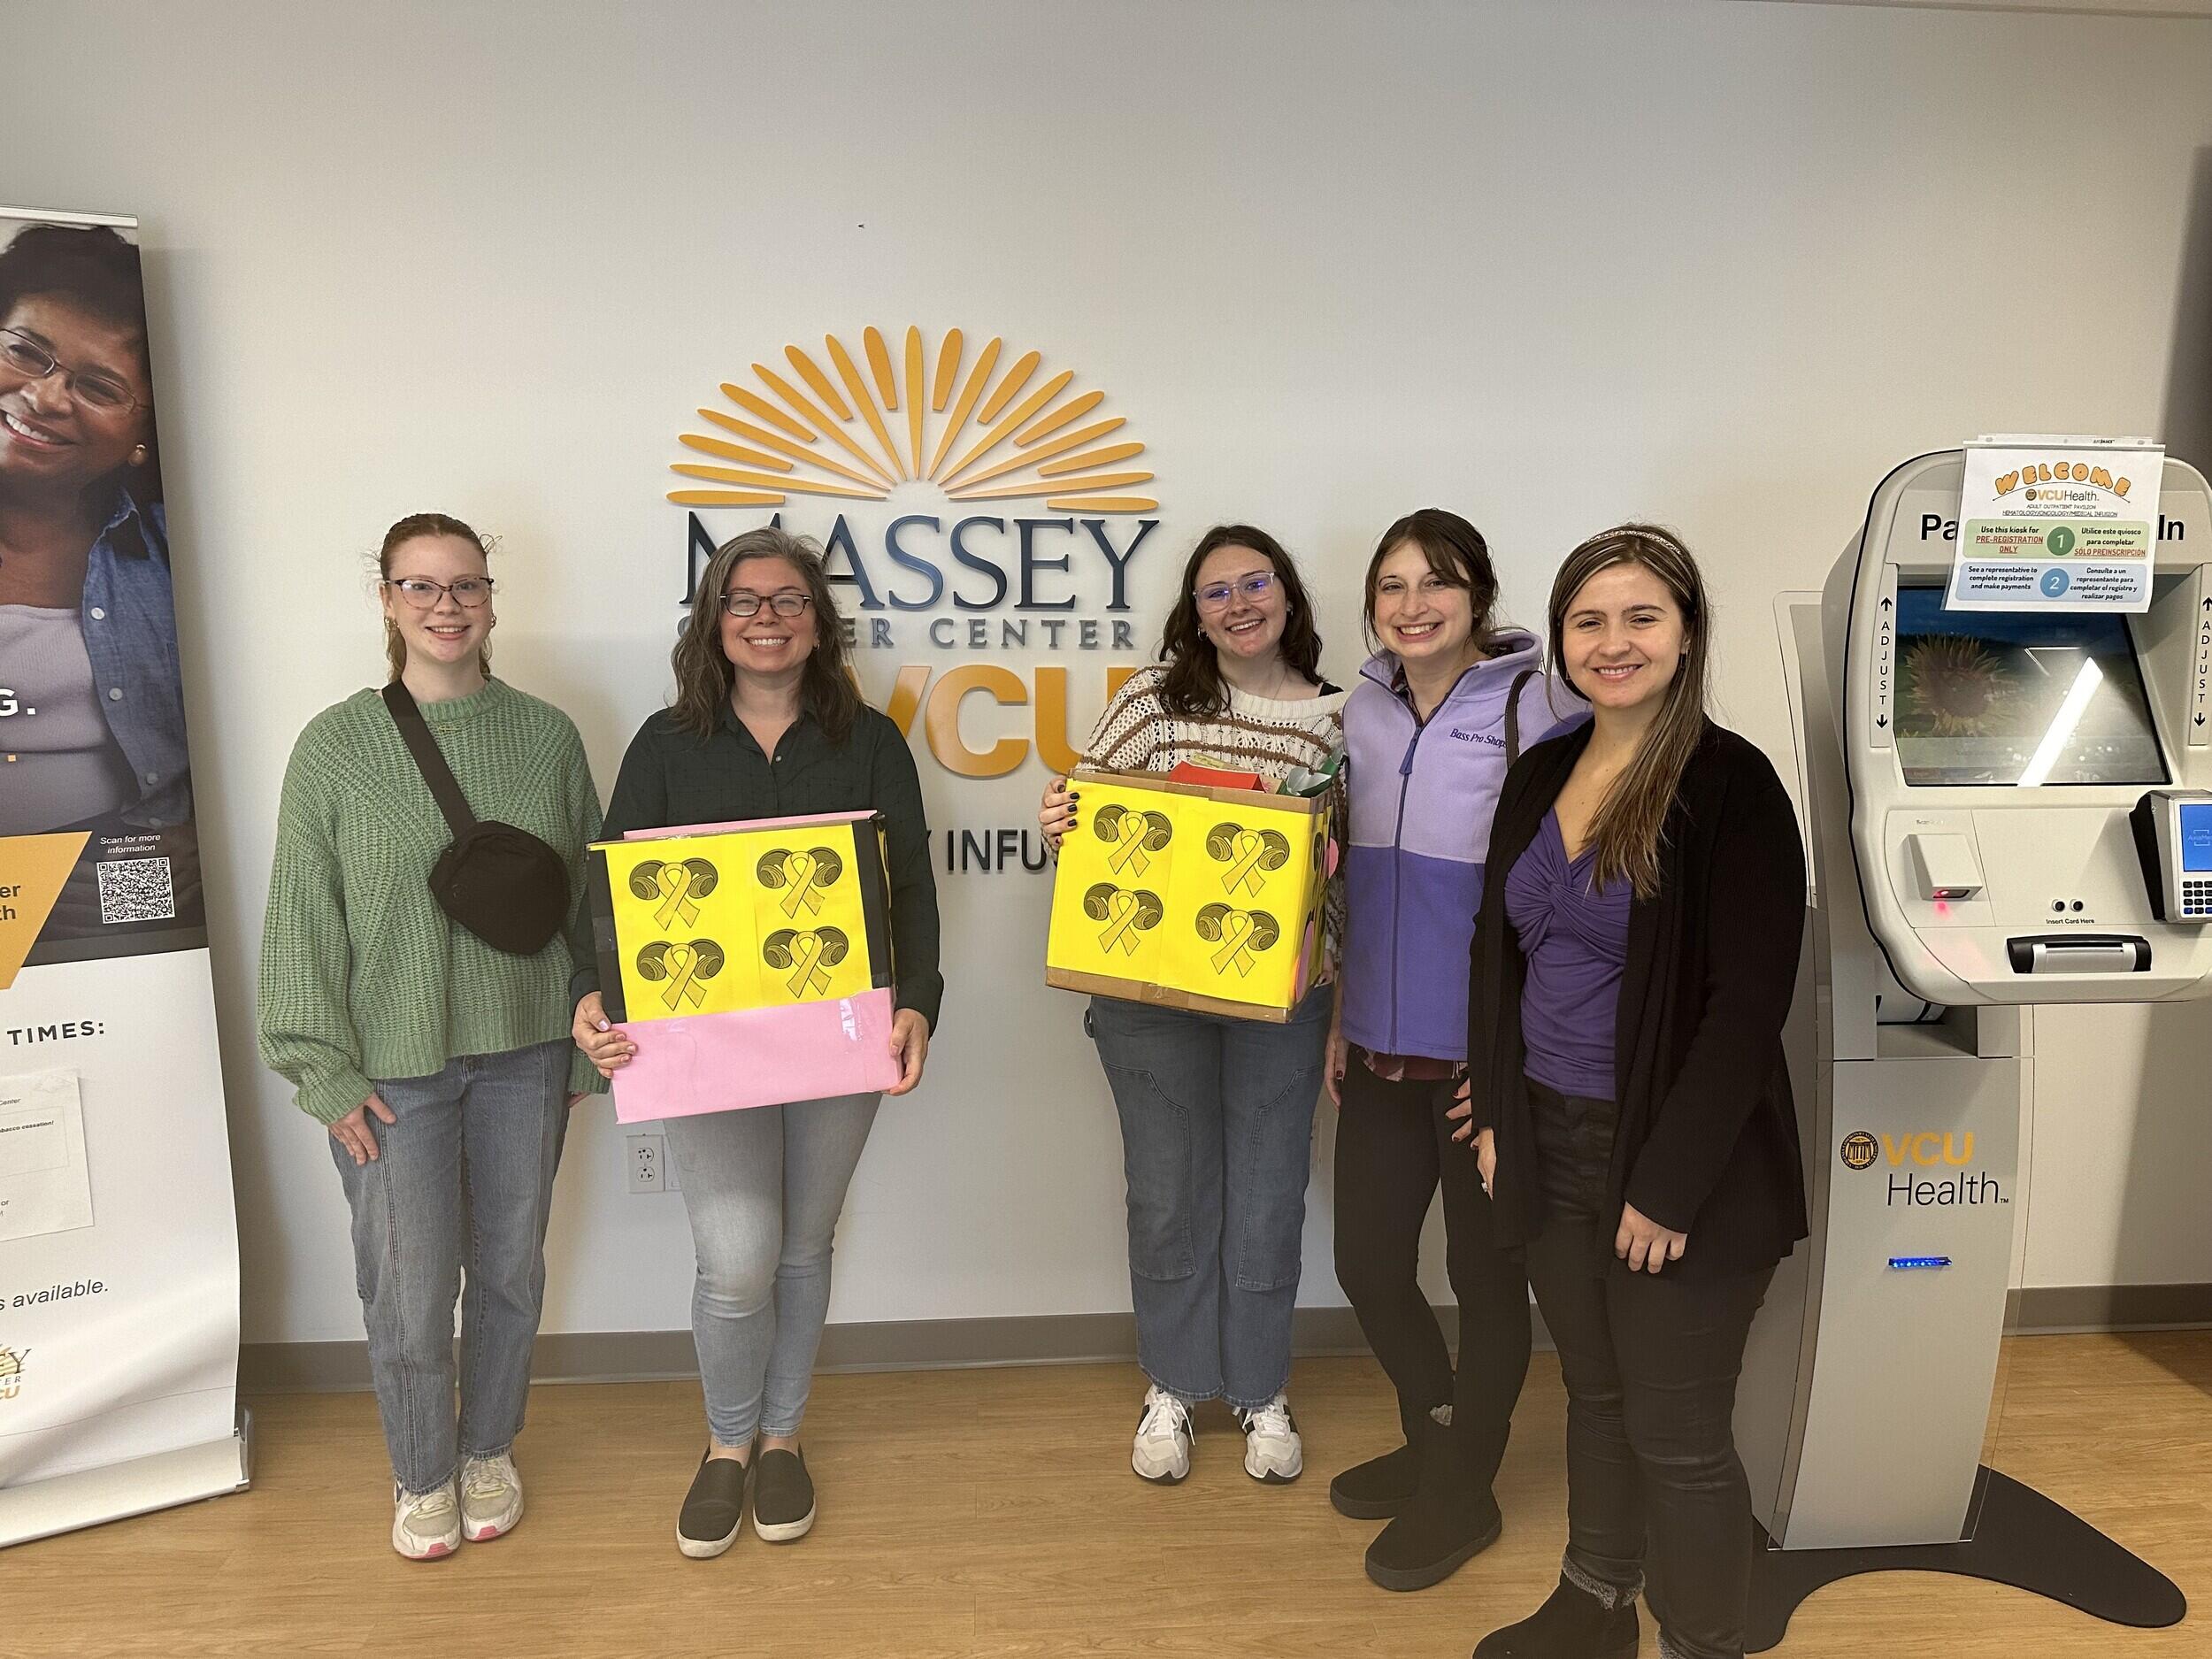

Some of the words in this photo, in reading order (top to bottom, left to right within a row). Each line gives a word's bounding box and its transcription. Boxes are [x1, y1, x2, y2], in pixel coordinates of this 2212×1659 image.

[1995, 462, 2131, 496] WELCOME
[1976, 535, 2044, 544] PRE-REGISTRATION
[1999, 545, 2018, 554] ONLY
[2056, 534, 2064, 548] 1
[2048, 577, 2060, 590] 2
[930, 618, 1134, 649] CENTER
[1879, 620, 1890, 705] ADJUST
[2198, 620, 2210, 703] ADJUST
[1450, 728, 1470, 741] Bass
[1470, 733, 1484, 742] Pro
[107, 844, 156, 854] information
[6, 1020, 104, 1046] TIMES:
[1881, 1131, 1975, 1167] VCU
[12, 1279, 108, 1308] available.
